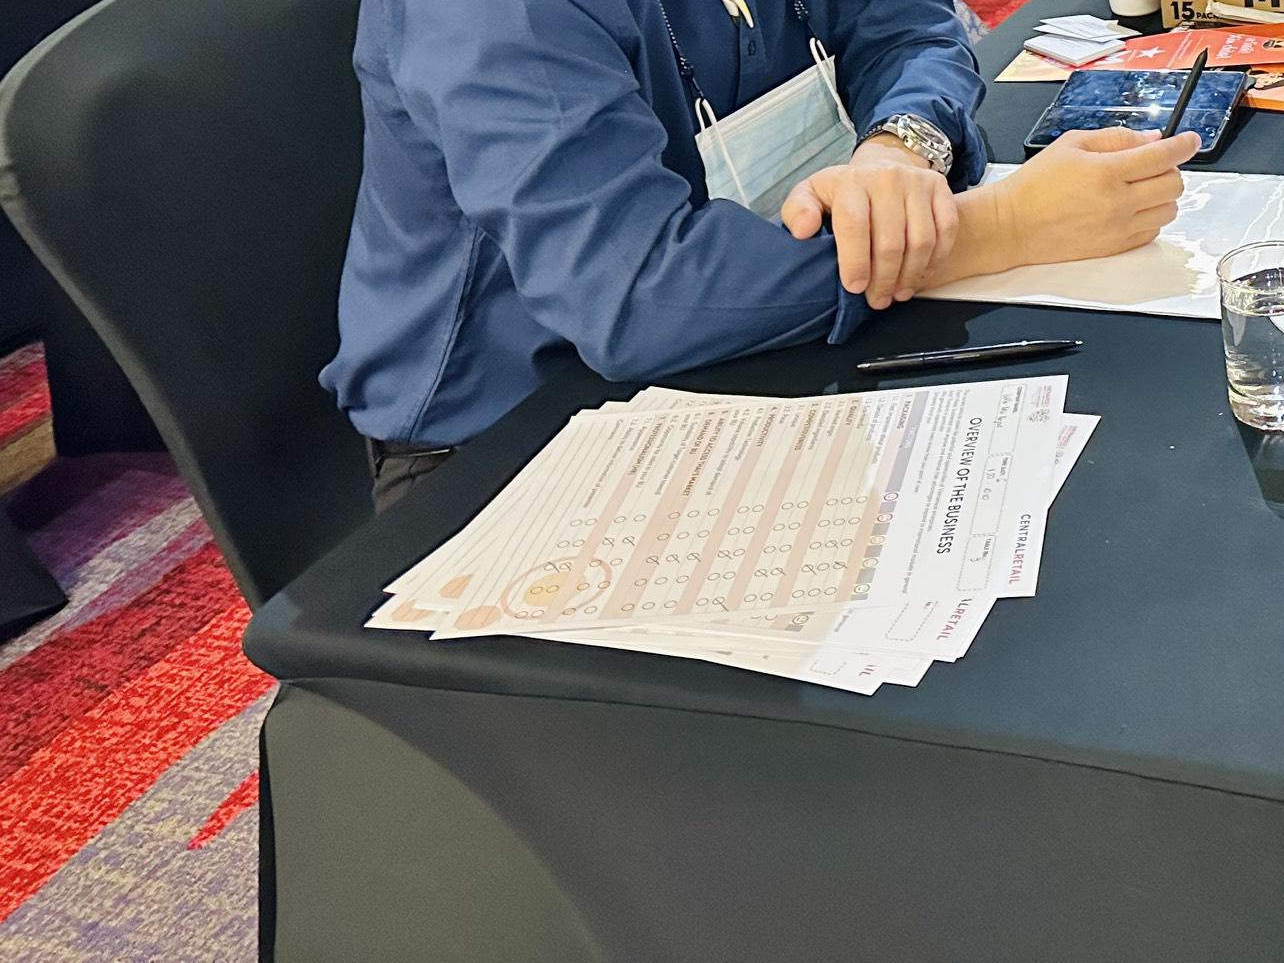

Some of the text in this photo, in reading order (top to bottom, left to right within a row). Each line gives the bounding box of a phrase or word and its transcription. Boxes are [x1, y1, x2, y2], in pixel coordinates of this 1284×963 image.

[1170, 2, 1195, 20] 15
[956, 416, 983, 466] OVERVIEW
[953, 467, 971, 481] OF
[947, 482, 967, 503] THE
[935, 504, 962, 555] BUSINESS
